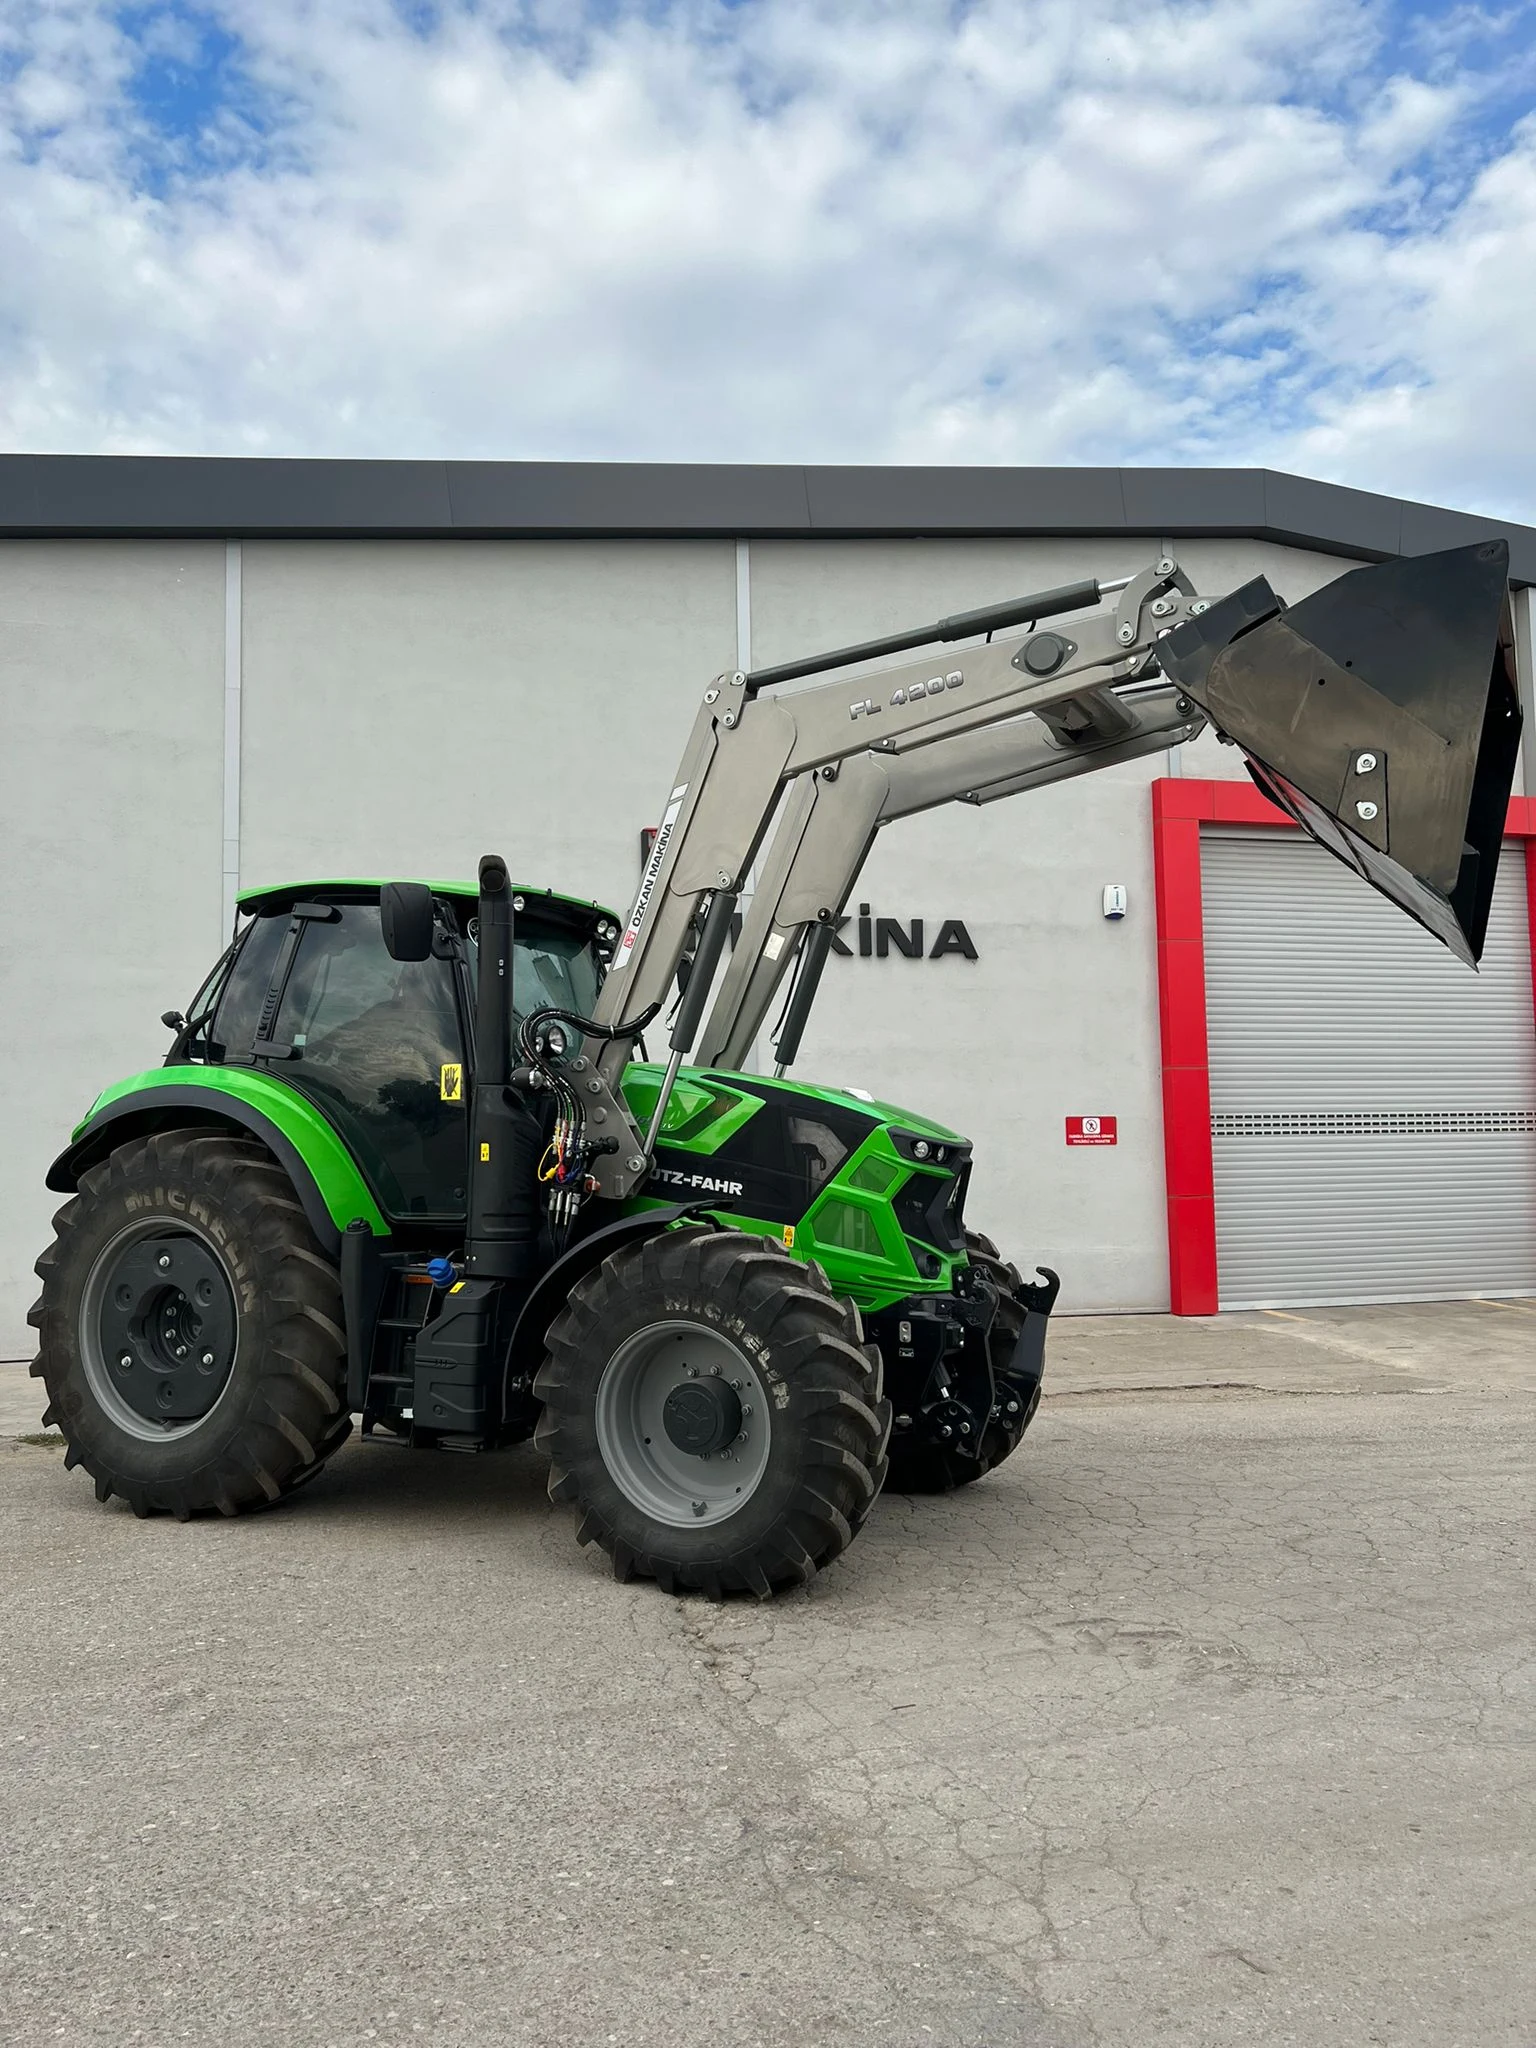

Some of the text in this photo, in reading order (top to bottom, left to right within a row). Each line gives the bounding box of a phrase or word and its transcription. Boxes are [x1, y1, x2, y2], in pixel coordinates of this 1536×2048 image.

[849, 669, 964, 720] FL 4200
[632, 823, 673, 928] ÖZKAN MAKİNA
[124, 1186, 256, 1313] MICHELIN
